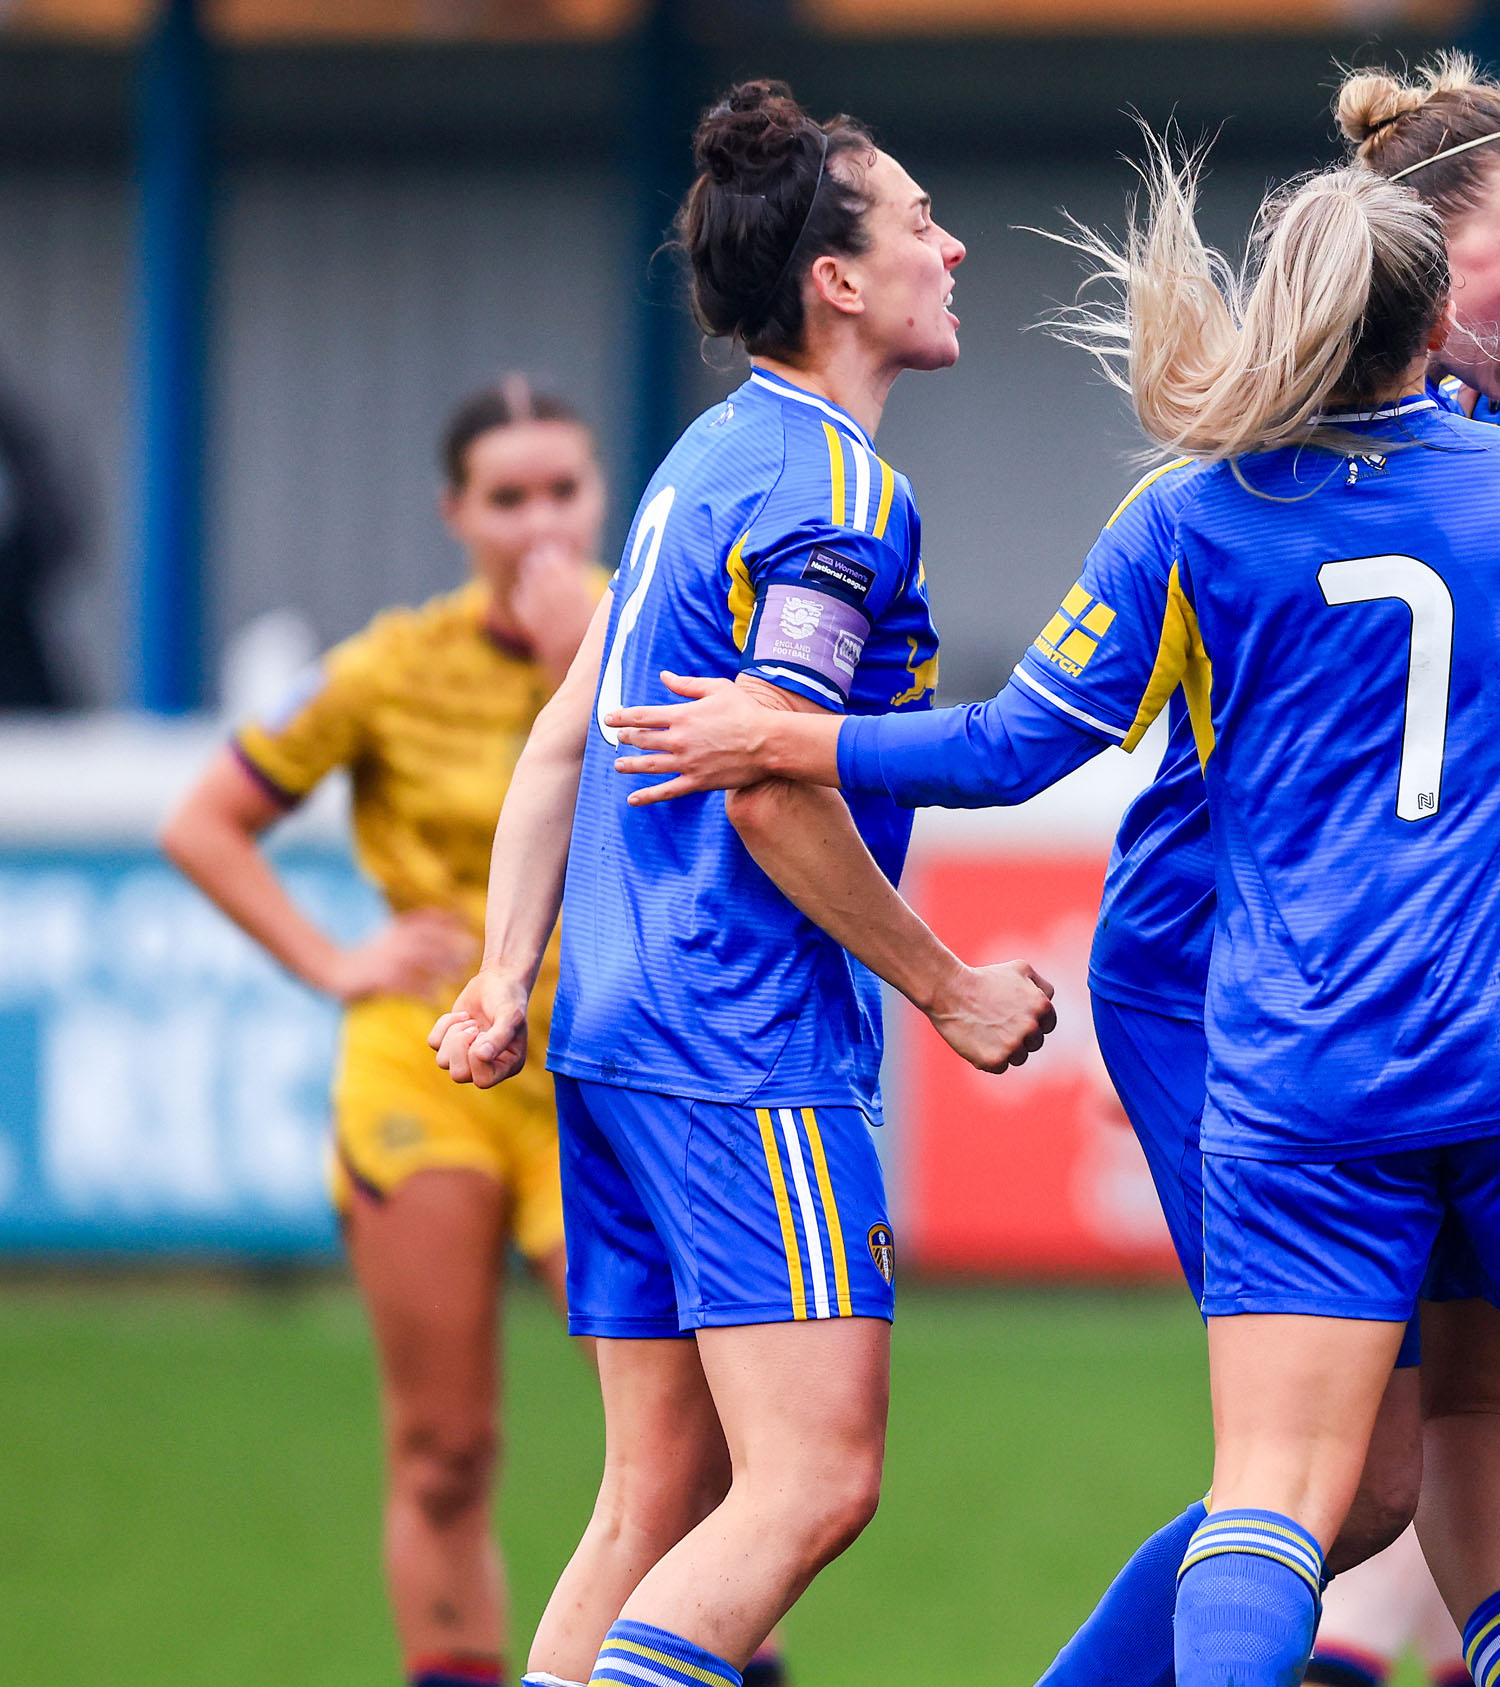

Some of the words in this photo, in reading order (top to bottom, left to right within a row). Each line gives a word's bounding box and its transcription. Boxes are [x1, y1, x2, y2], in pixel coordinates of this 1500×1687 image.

[810, 560, 843, 580] National
[841, 575, 867, 593] League
[771, 647, 812, 662] FOOTBALL
[774, 639, 812, 654] ENGLAND
[1316, 554, 1455, 822] 7
